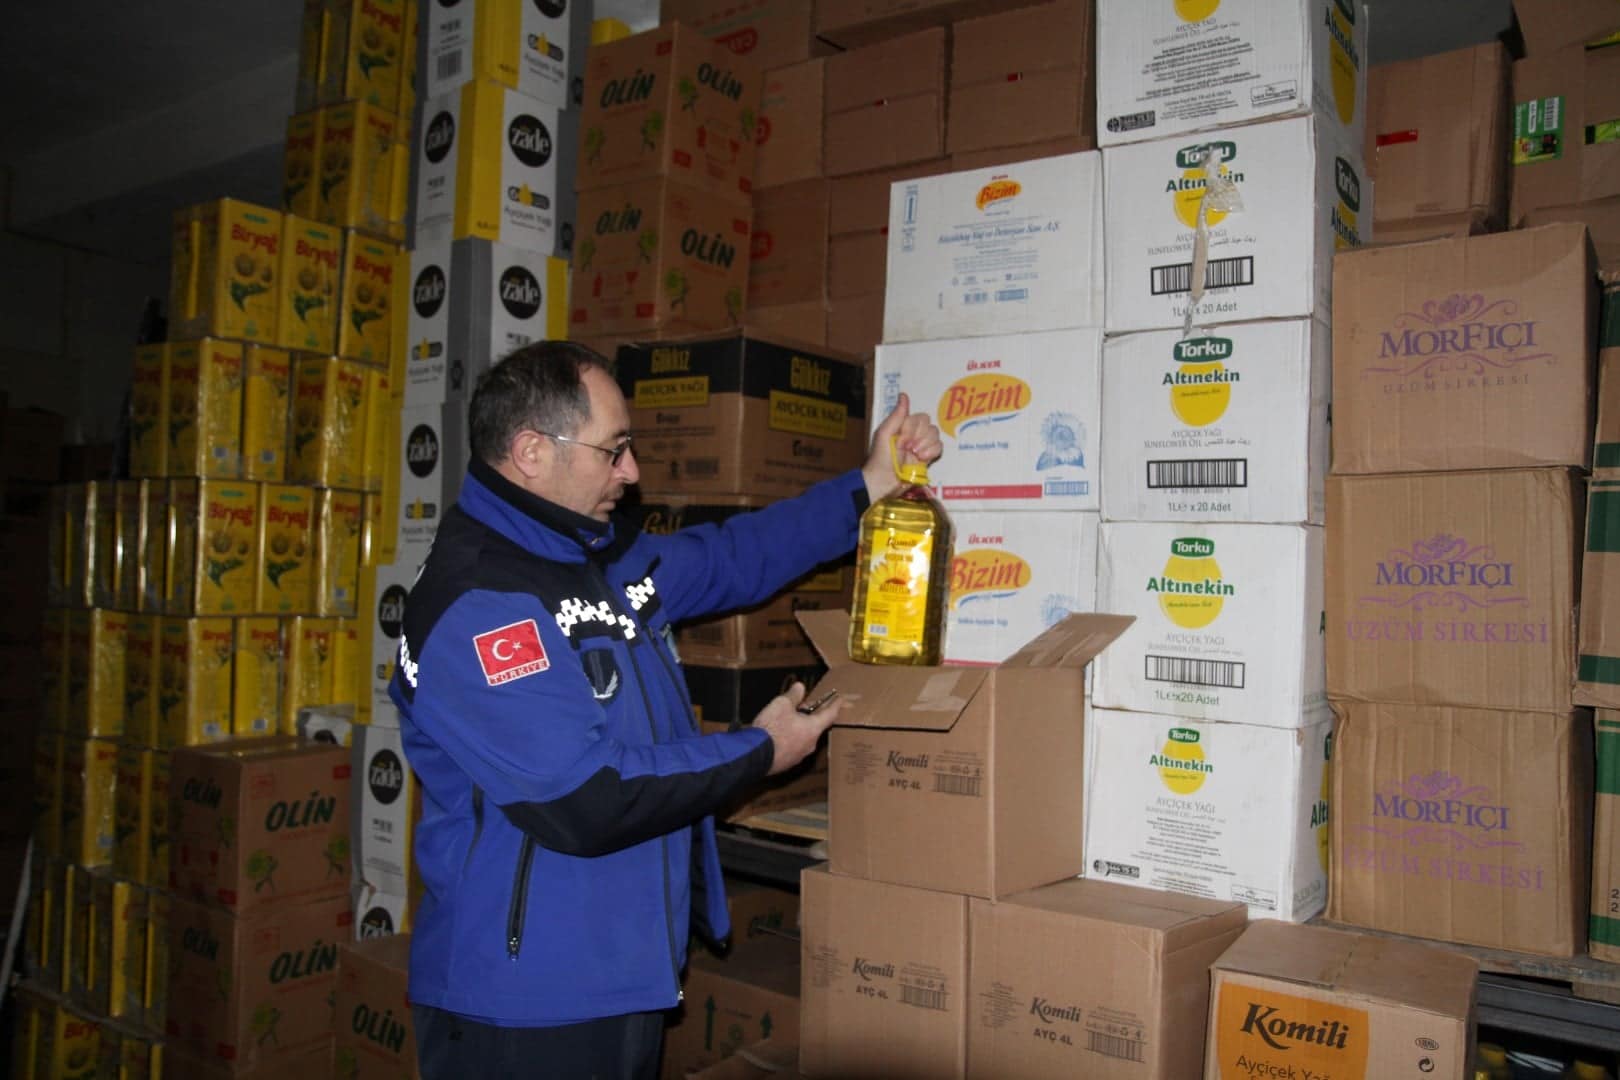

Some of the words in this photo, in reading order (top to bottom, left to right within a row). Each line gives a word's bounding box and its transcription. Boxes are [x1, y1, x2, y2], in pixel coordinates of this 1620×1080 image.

[600, 67, 656, 109] OLİN
[697, 62, 743, 101] OLİN
[680, 228, 736, 269] OLİN
[1179, 340, 1227, 358] Torku
[1162, 368, 1240, 386] Altınekin
[945, 381, 1023, 421] Bizim
[1196, 502, 1209, 512] 20
[1210, 501, 1231, 512] Adet
[1175, 541, 1210, 554] Torku
[950, 557, 1023, 591] Bizim
[1146, 576, 1235, 596] Altınekin
[1171, 730, 1197, 741] Torku
[886, 750, 929, 773] Komili
[1149, 753, 1214, 774] Altınekin
[265, 790, 337, 832] OLİN
[269, 939, 337, 984] OLİN
[852, 957, 895, 981] Komili
[1030, 997, 1082, 1024] Komili
[351, 1003, 406, 1054] OLİN
[1033, 1027, 1056, 1043] AYÇ
[1058, 1033, 1074, 1046] 4L
[1240, 1002, 1350, 1050] Komili
